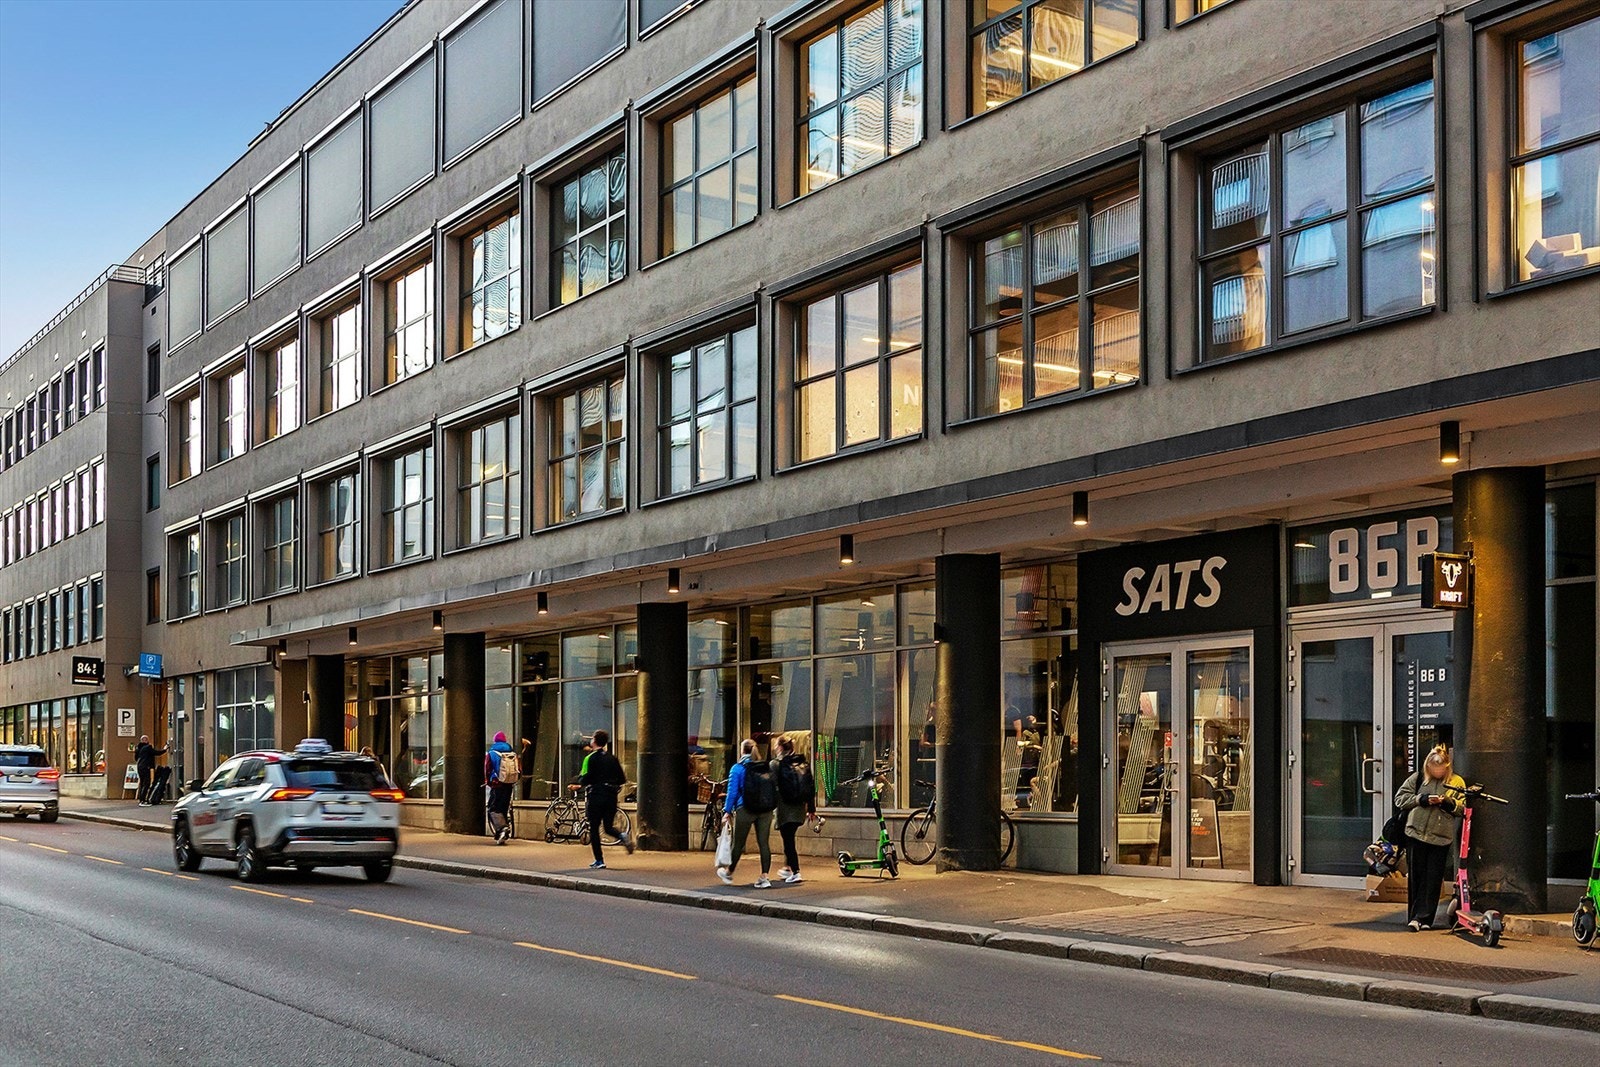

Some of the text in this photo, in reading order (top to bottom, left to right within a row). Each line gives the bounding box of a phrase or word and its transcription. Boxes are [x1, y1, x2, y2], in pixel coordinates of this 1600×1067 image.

[1114, 555, 1228, 616] SATS
[77, 662, 92, 674] 84
[1420, 668, 1446, 682] 86 B
[122, 710, 131, 724] P
